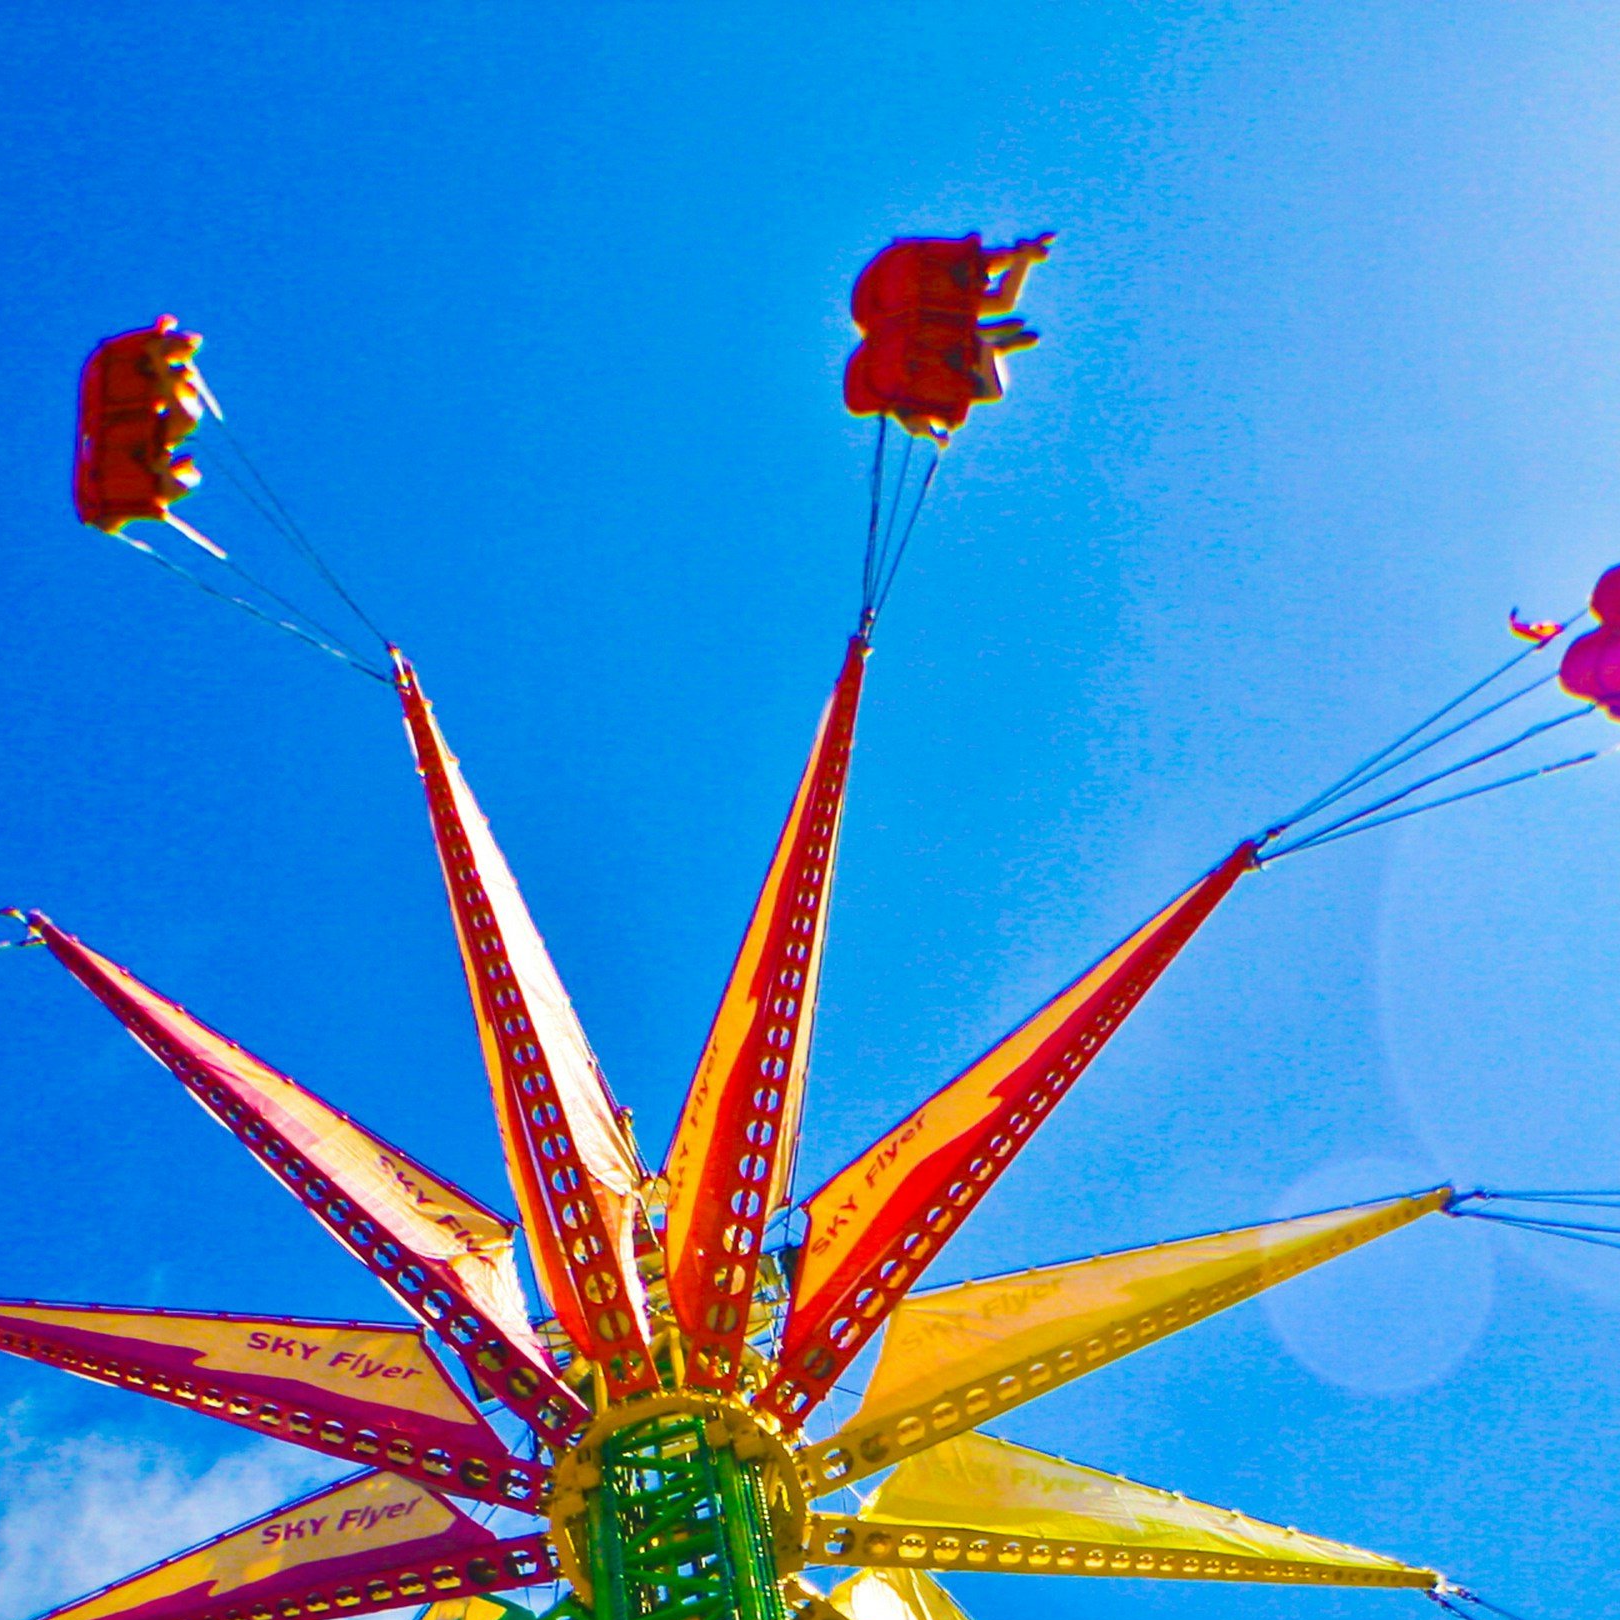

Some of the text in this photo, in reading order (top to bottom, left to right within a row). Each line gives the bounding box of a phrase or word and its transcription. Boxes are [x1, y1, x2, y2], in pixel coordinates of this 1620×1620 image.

[811, 1113, 926, 1256] SKY Flyer
[247, 1331, 422, 1382] SKY Flyer
[261, 1496, 422, 1546] SKY Flyer
